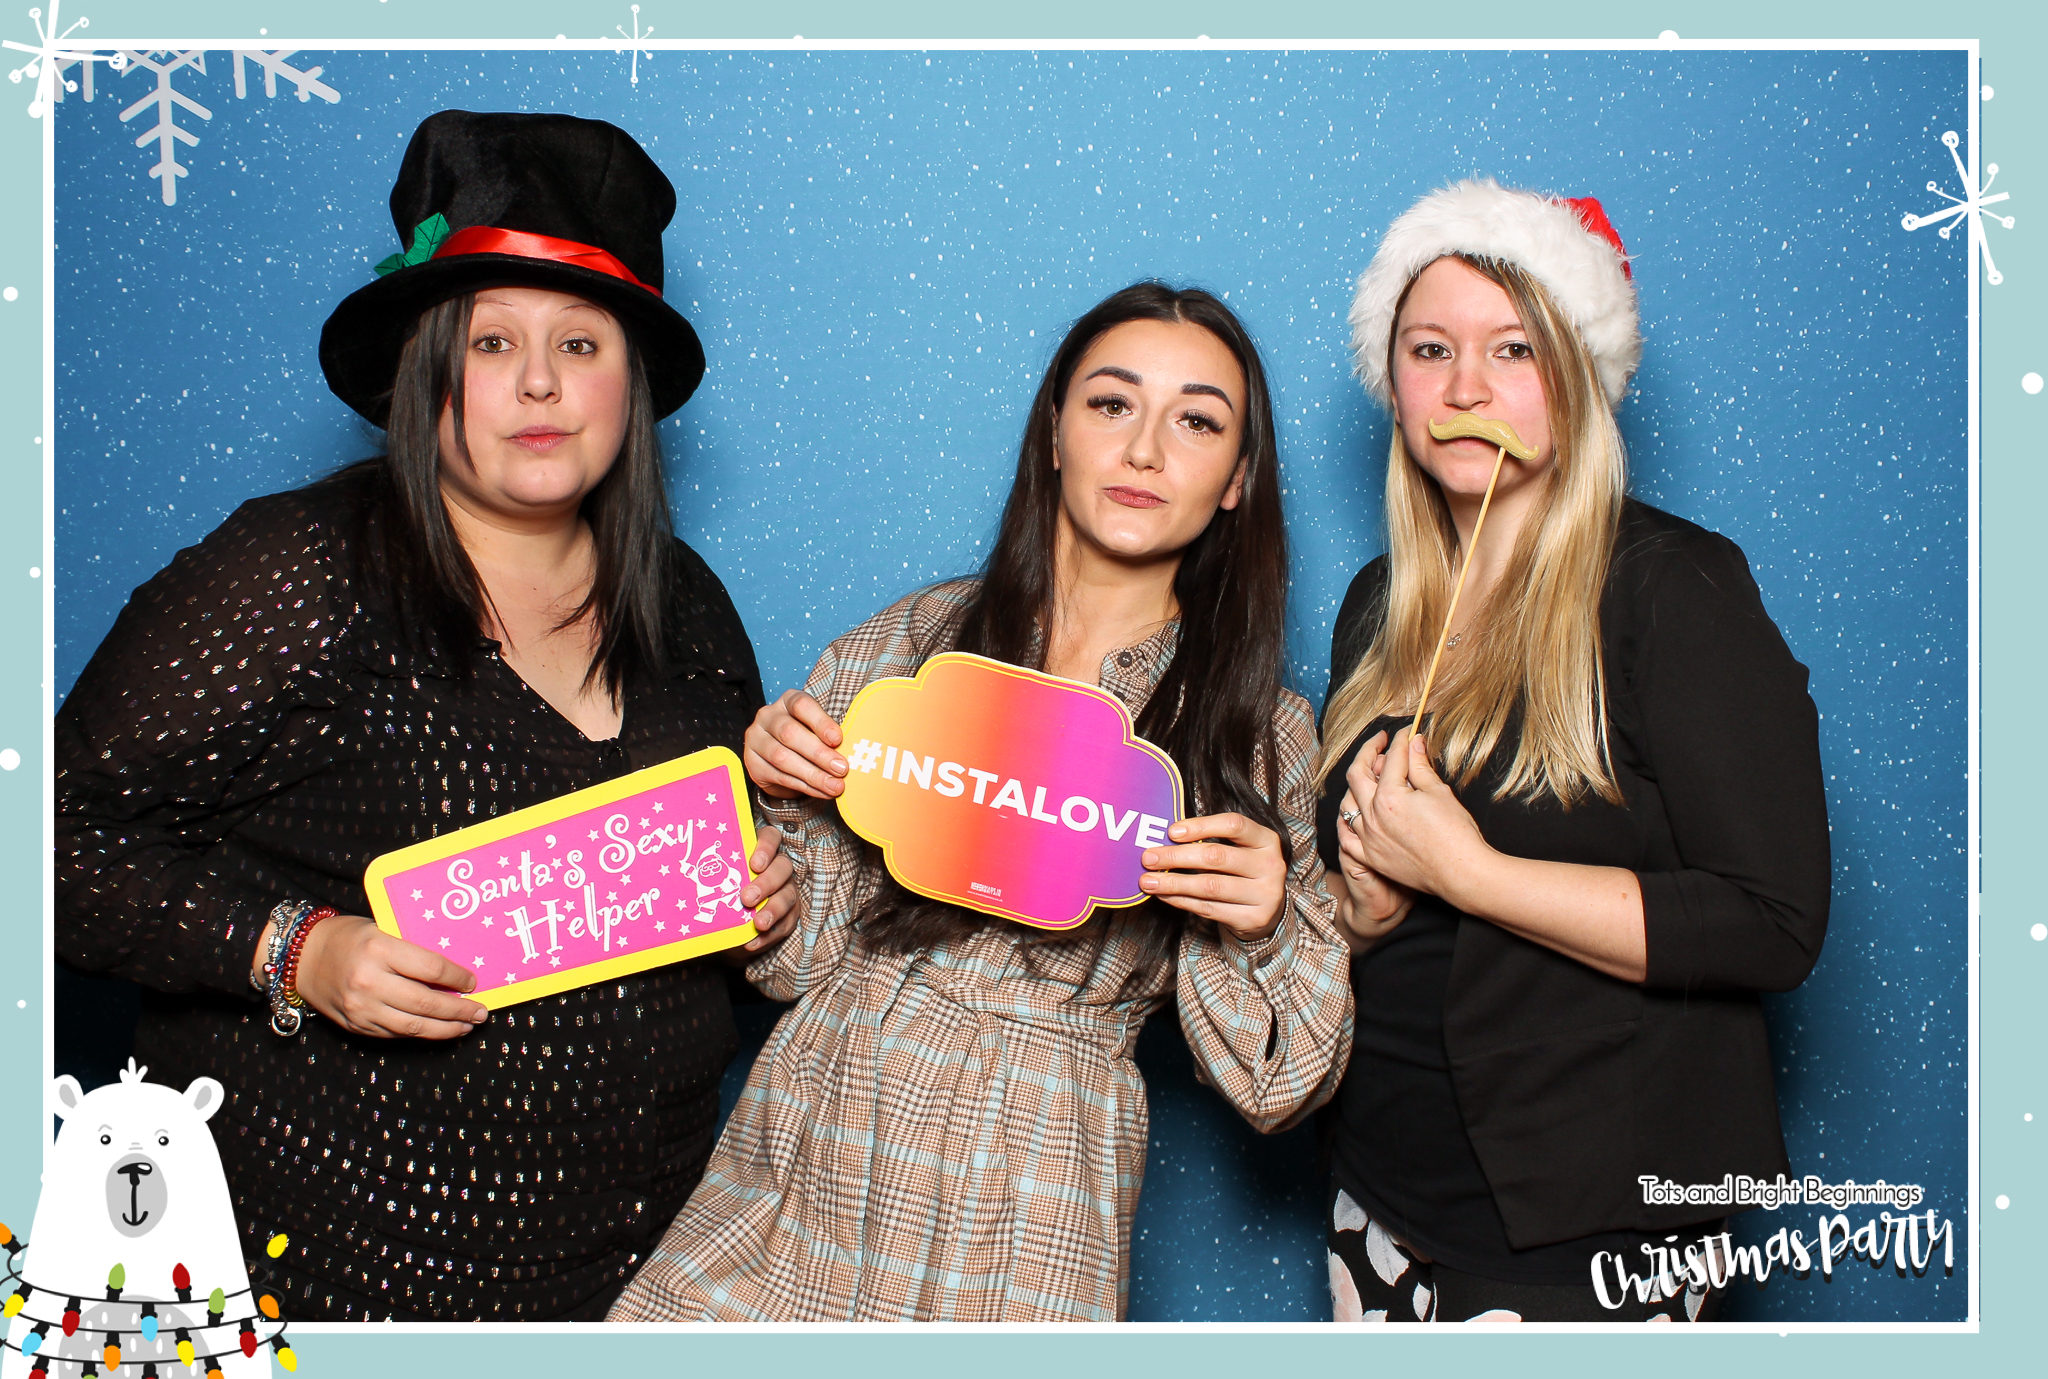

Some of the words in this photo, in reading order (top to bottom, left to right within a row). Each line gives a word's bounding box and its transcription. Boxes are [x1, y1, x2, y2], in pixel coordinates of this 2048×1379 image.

[848, 738, 1169, 850] #INSTALOVE
[440, 835, 586, 921] Santa's
[598, 813, 694, 873] Sexy
[504, 882, 661, 964] Helper
